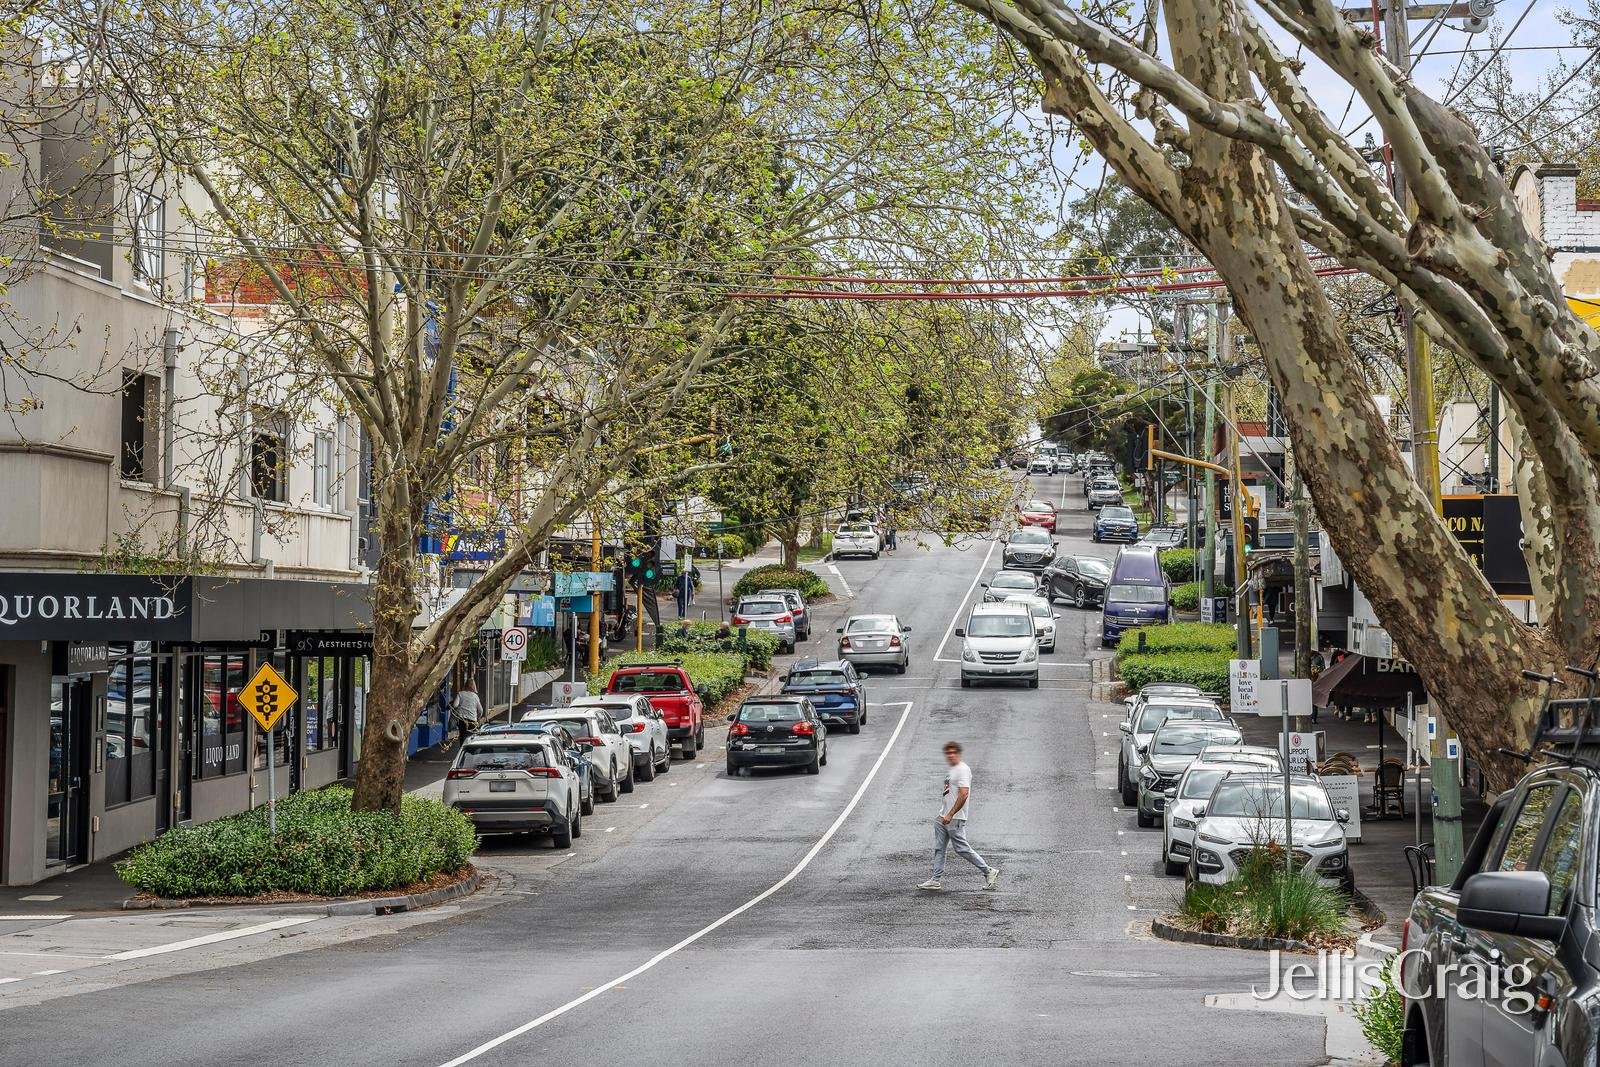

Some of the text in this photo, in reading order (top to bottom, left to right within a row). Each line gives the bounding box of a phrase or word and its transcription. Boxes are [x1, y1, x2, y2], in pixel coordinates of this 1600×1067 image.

[317, 639, 374, 649] AESTHETSTU
[506, 634, 523, 646] 40
[205, 743, 240, 767] LIQUOLAND
